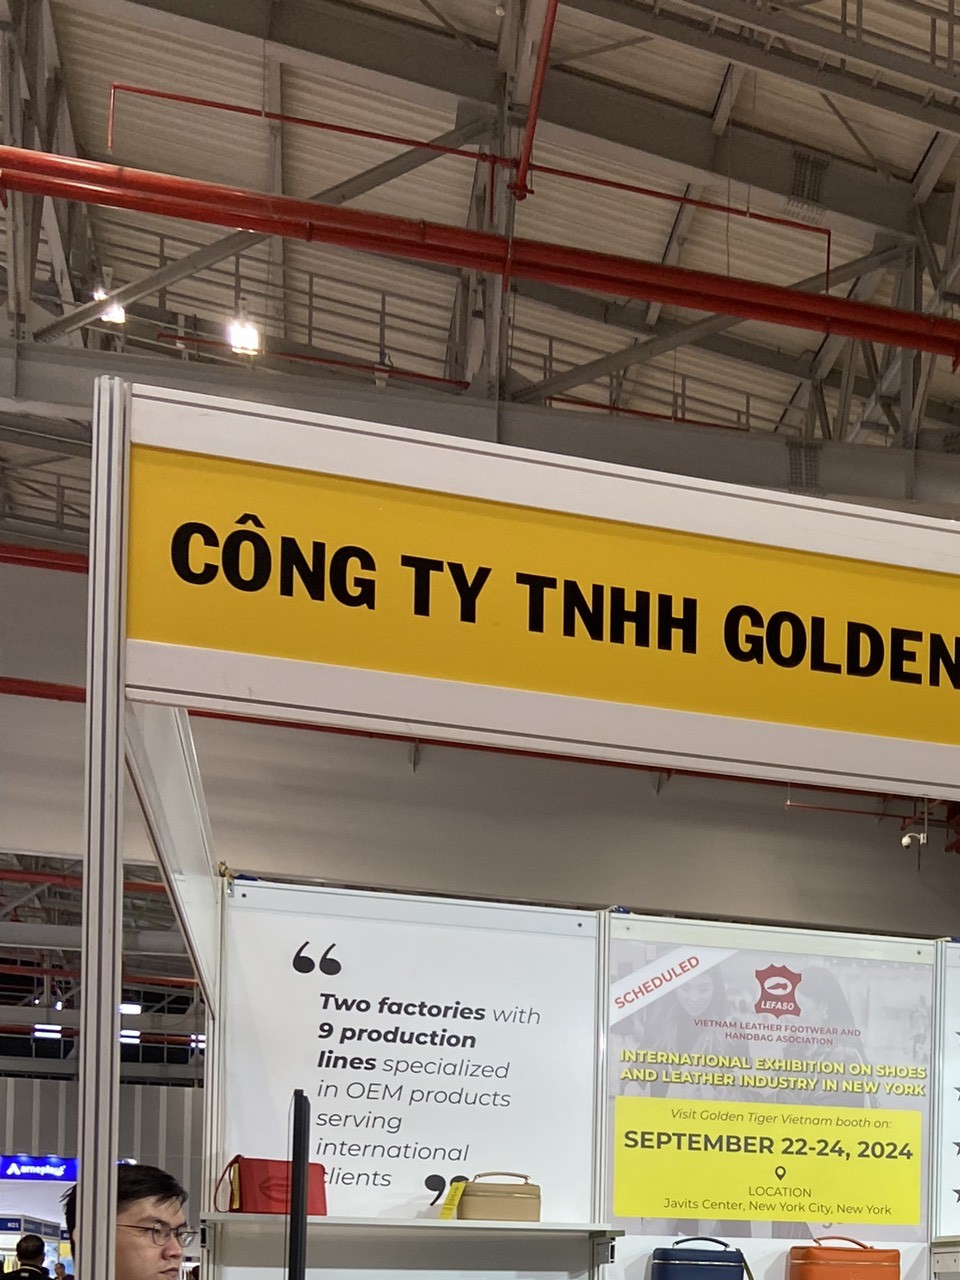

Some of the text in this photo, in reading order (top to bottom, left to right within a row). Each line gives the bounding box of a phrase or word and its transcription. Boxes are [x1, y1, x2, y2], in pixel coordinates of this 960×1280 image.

[170, 513, 376, 610] CÔNG
[401, 554, 492, 623] TY
[516, 572, 697, 654] TNHH
[615, 956, 699, 1009] SCHEDULED
[320, 993, 540, 1025] Two factories with
[761, 1001, 794, 1010] LEFASO
[318, 1022, 476, 1048] 9 production
[694, 1019, 861, 1037] VIETNAM LEATHER FOOTWEAR AND
[725, 1032, 833, 1045] HANDBAG ASOCIATION
[317, 1050, 510, 1078] lines specialized
[620, 1050, 927, 1079] INTERNATIONAL EXHIBITION ON SHOES
[317, 1080, 511, 1107] in OEM products
[620, 1068, 926, 1097] AND LEATHER INDUSTRY IN NEW YORK
[316, 1111, 402, 1134] serving
[671, 1109, 892, 1129] Visit Golden Tiger Vietnam booth on:
[316, 1138, 469, 1161] international
[624, 1130, 913, 1161] SEPTEMBER 22-24, 2024
[748, 1186, 812, 1198] LOCATION
[663, 1198, 892, 1215] Javits Center, New York City, New York
